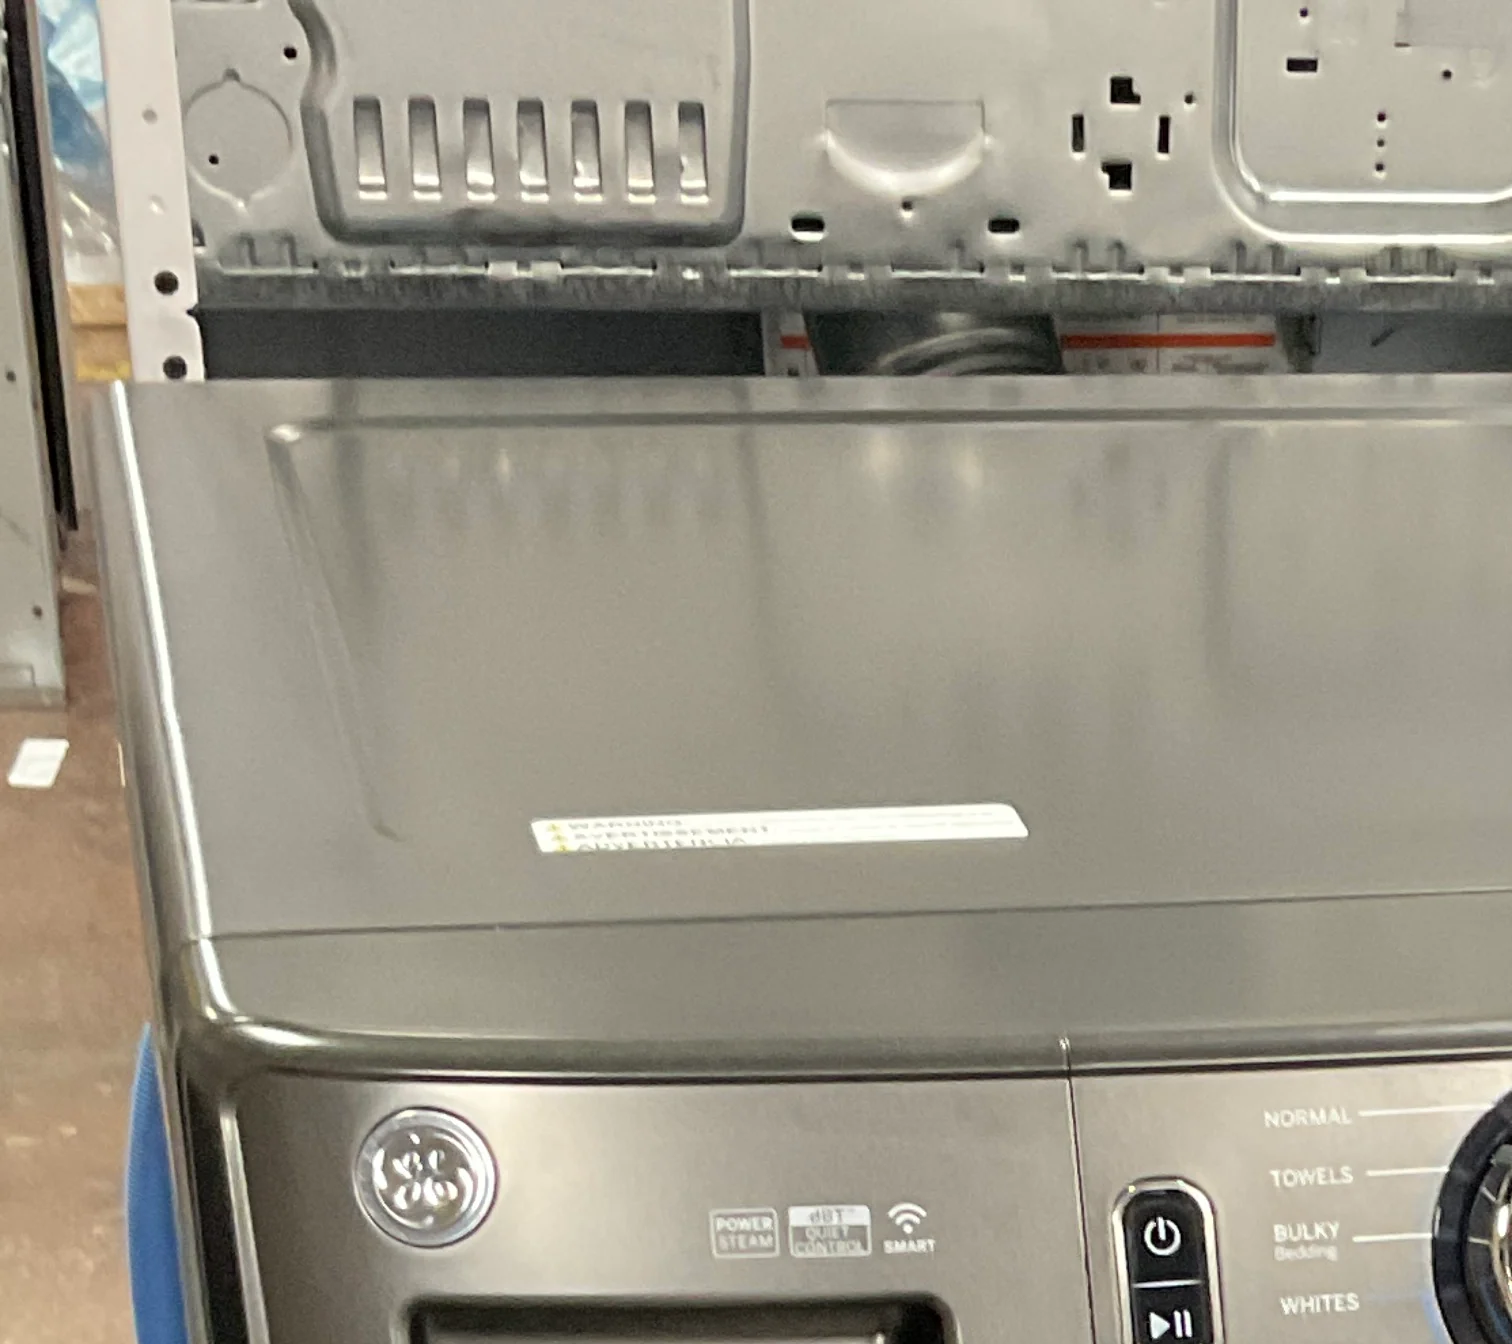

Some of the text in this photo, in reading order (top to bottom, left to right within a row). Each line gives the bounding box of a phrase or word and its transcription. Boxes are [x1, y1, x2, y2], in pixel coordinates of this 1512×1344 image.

[1263, 1107, 1354, 1128] NORMAL
[1269, 1166, 1354, 1189] TOWELS
[715, 1216, 774, 1233] POWER
[1272, 1220, 1341, 1244] BULKY
[718, 1233, 774, 1250] STEAM
[883, 1238, 936, 1255] SMART
[1280, 1292, 1361, 1316] WHITES
